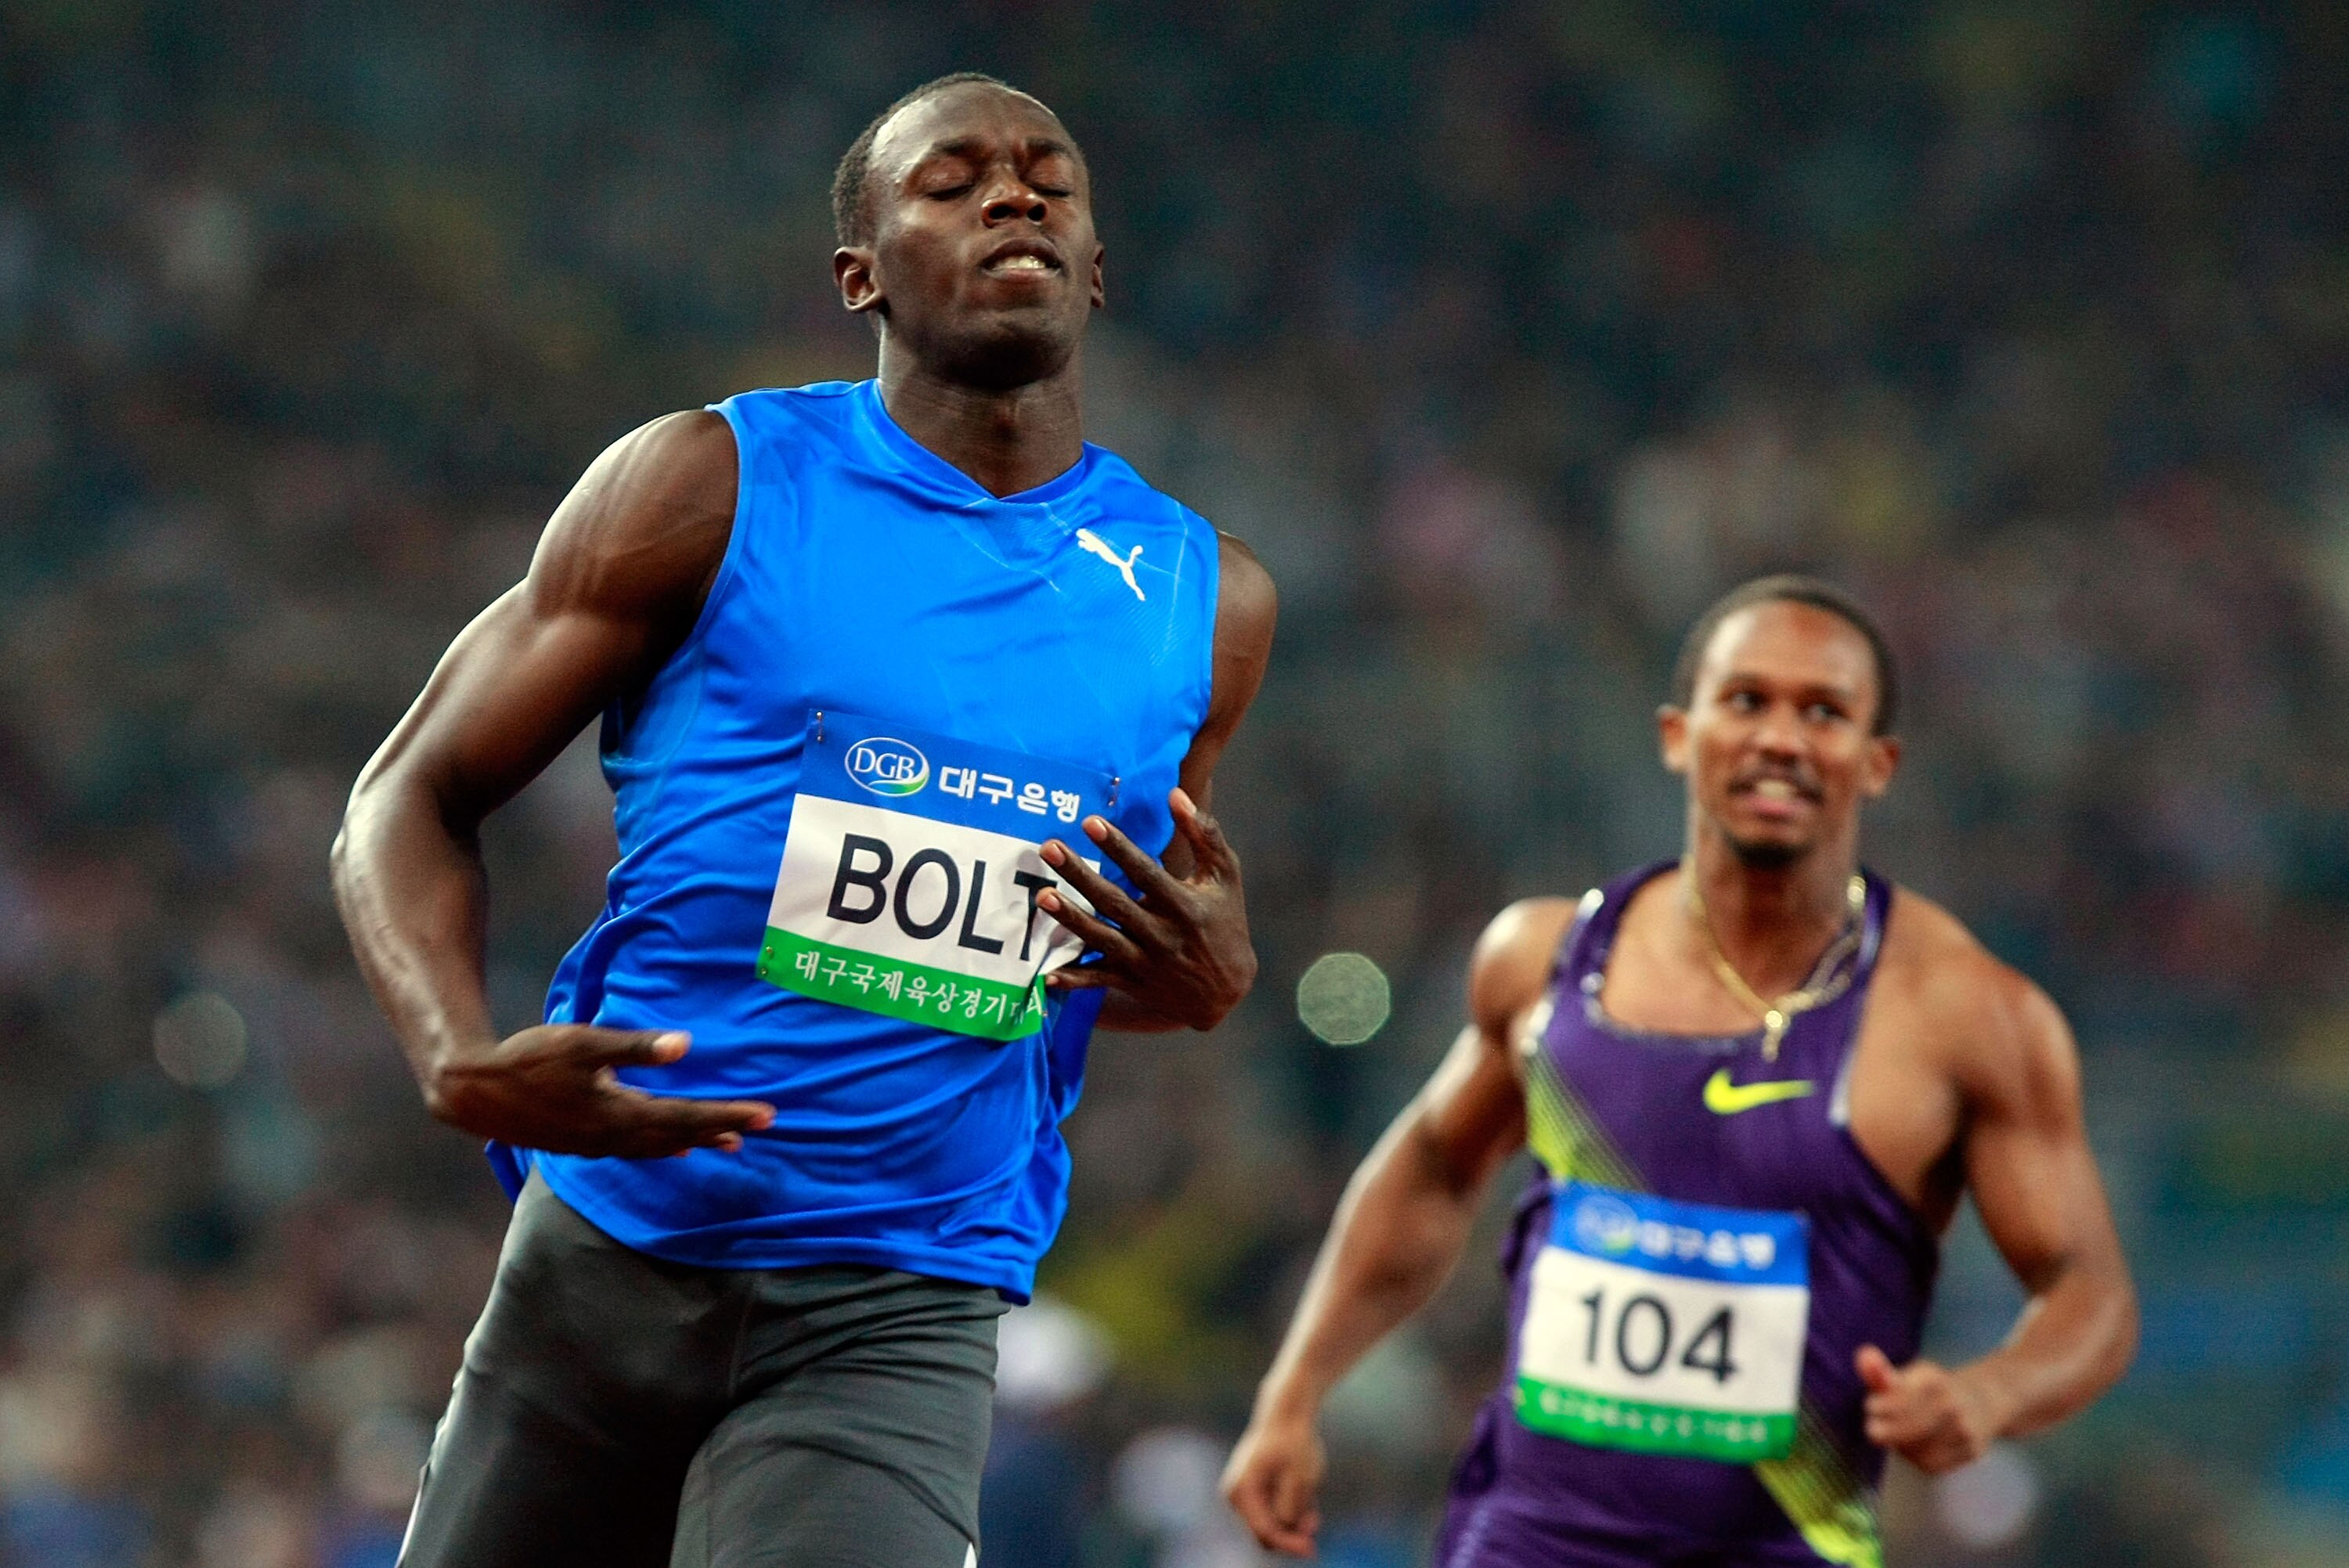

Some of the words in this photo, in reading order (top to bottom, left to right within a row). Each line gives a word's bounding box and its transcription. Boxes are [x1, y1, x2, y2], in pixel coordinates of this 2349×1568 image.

[853, 746, 915, 781] DGB
[938, 766, 1081, 824] 대구은행
[826, 833, 1056, 962] BOLT
[1580, 1285, 1738, 1385] 104
